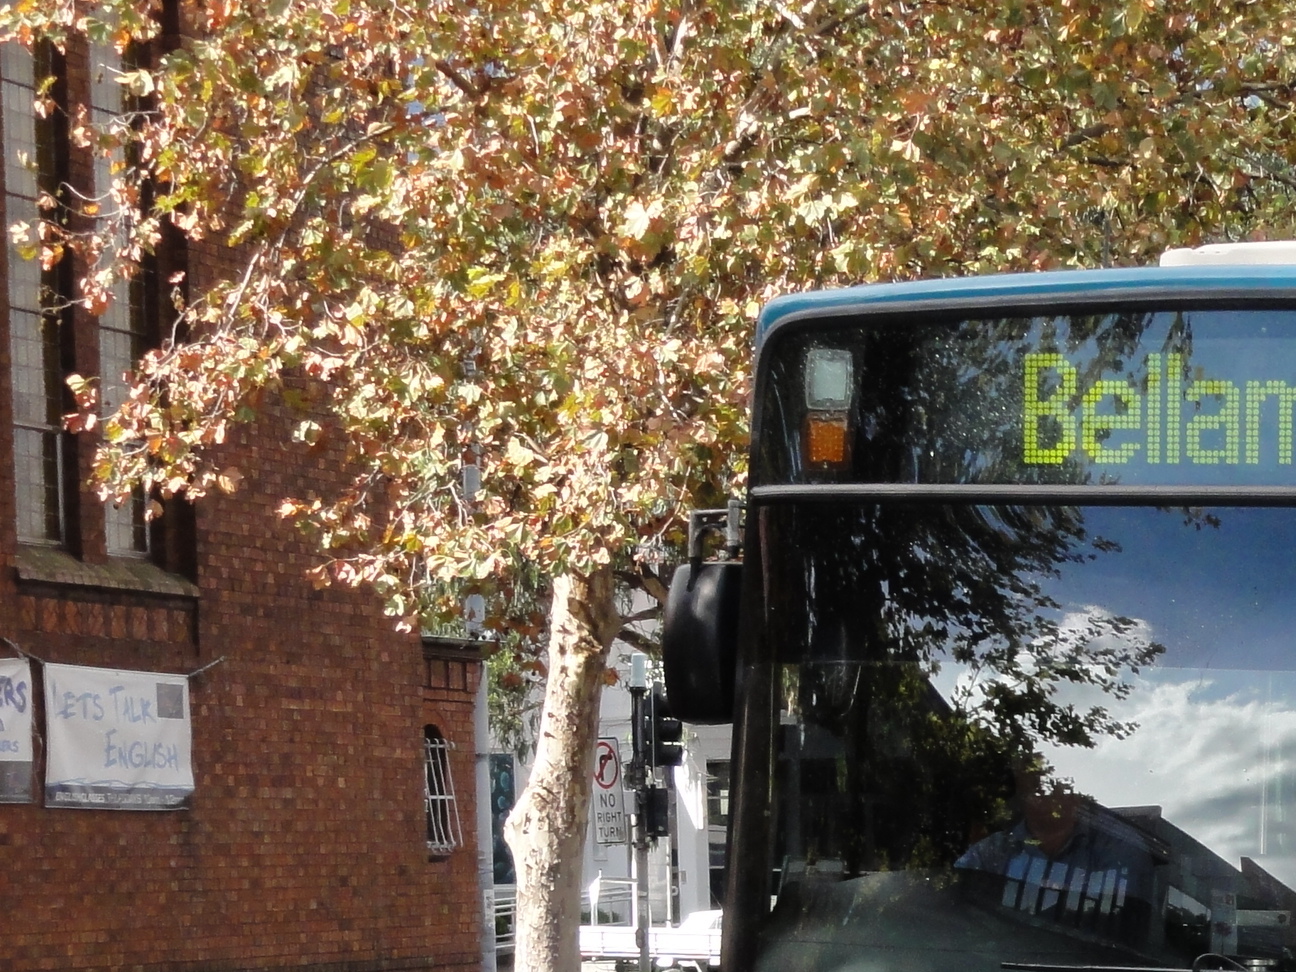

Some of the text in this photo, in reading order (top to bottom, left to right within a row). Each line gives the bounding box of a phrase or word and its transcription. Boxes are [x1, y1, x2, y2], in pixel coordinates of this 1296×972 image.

[104, 728, 179, 771] ENGLISH
[600, 793, 616, 808] NO
[597, 811, 622, 824] RIGHT
[598, 825, 622, 838] TURN
